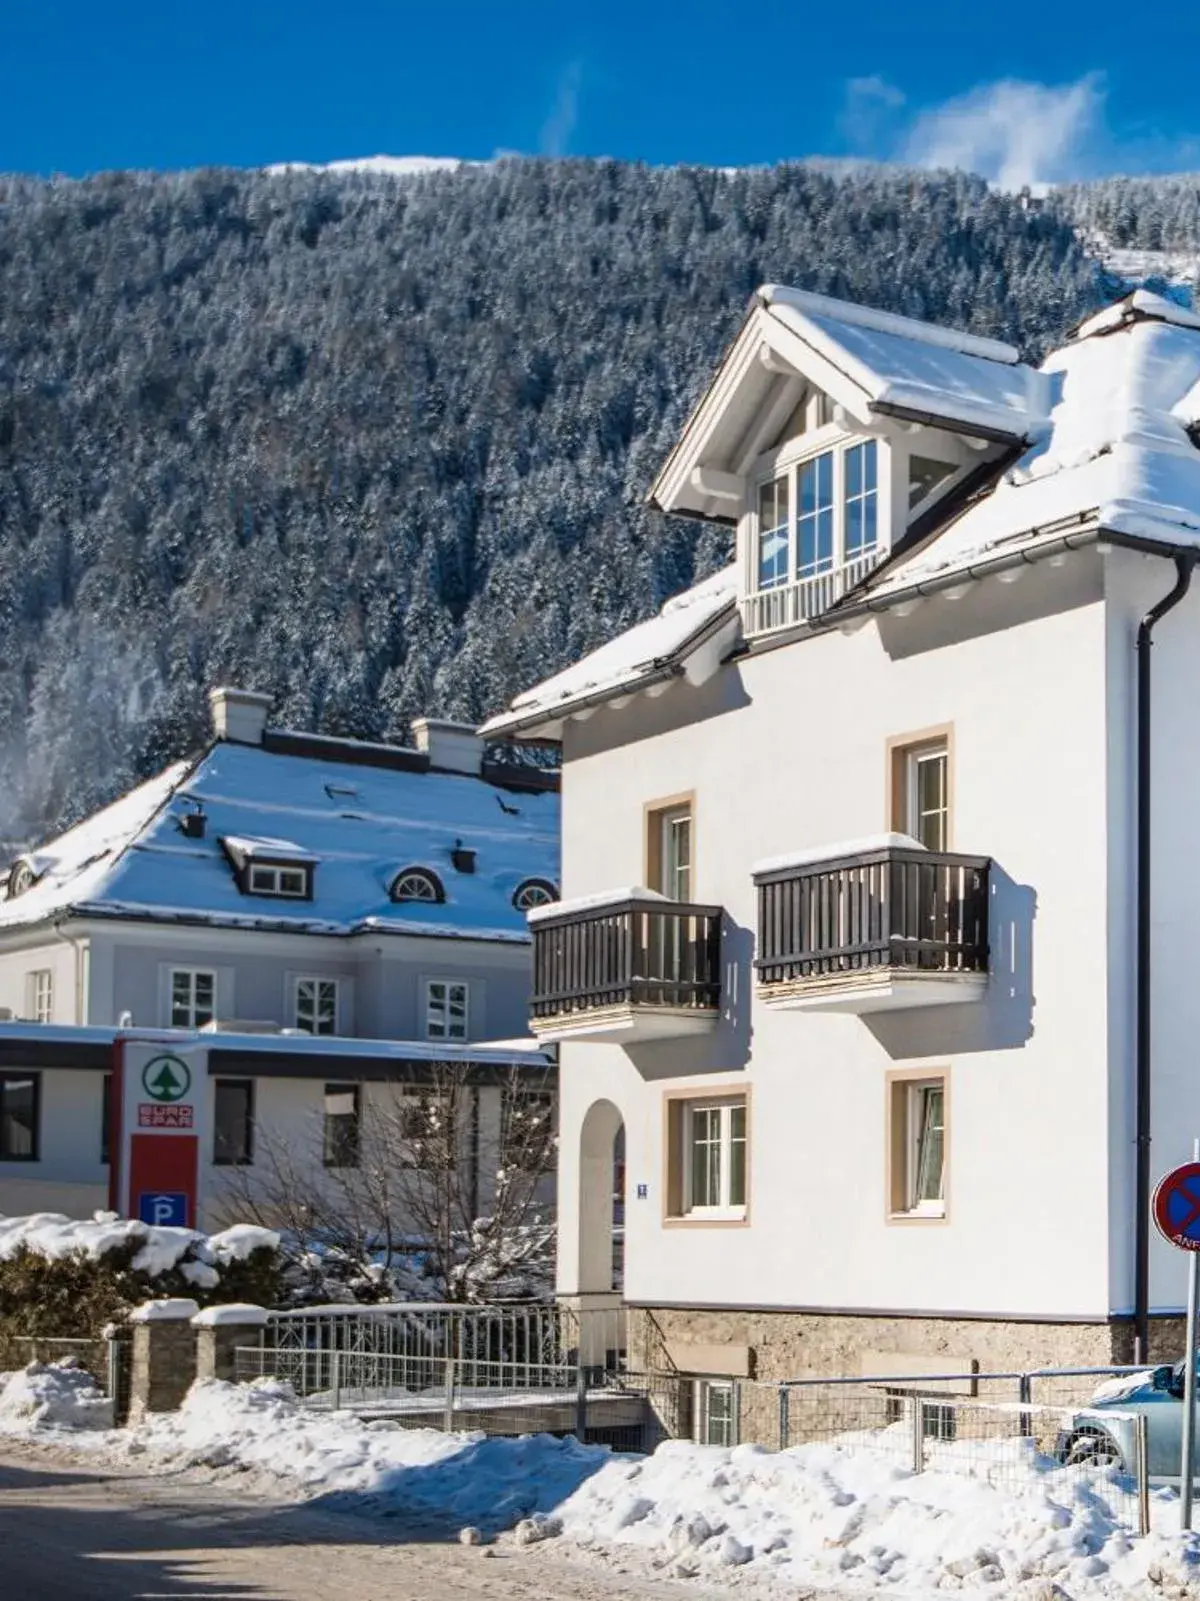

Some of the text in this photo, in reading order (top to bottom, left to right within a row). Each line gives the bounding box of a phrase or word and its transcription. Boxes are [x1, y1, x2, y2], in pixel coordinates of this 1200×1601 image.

[140, 1106, 192, 1117] EURO
[140, 1116, 193, 1127] SPAR
[154, 1204, 174, 1226] P
